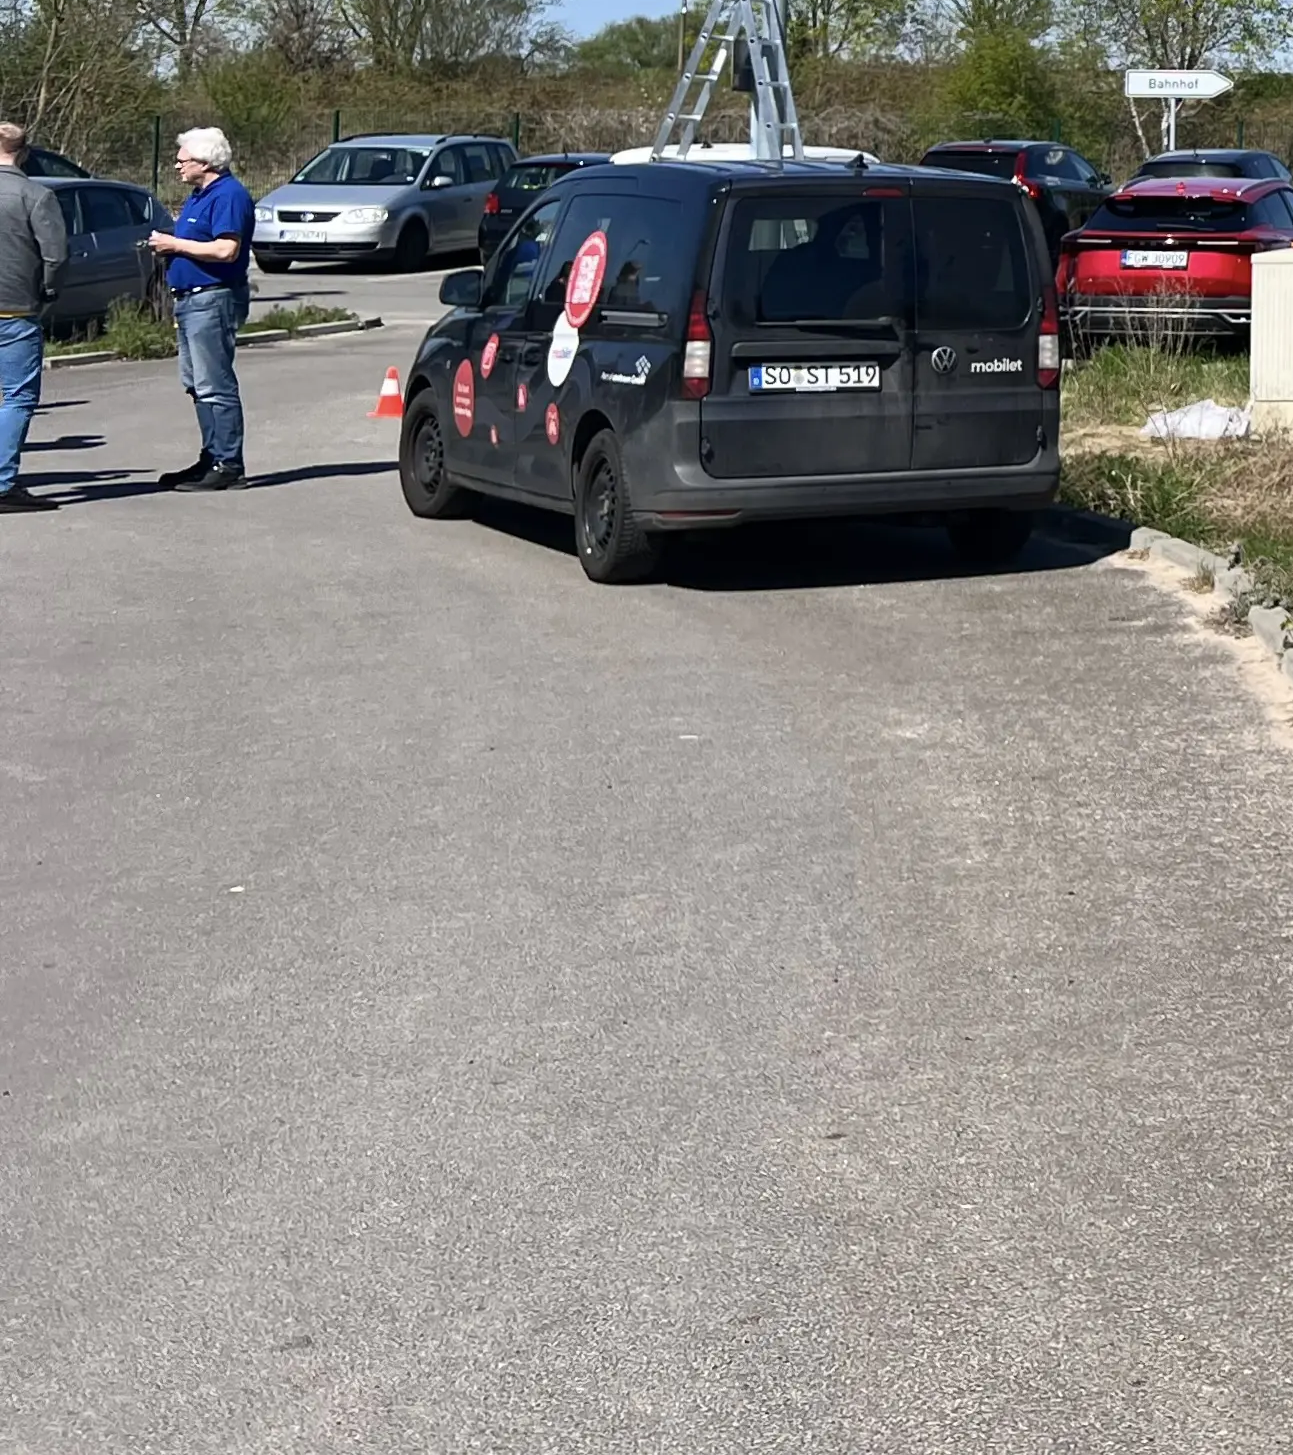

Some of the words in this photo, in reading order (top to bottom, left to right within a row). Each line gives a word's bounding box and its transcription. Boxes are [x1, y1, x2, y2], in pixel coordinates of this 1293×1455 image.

[1148, 78, 1199, 89] Bahnhof
[970, 358, 1023, 374] mobilet
[764, 365, 792, 386] SO
[806, 365, 832, 386] ST
[838, 365, 878, 386] 519
